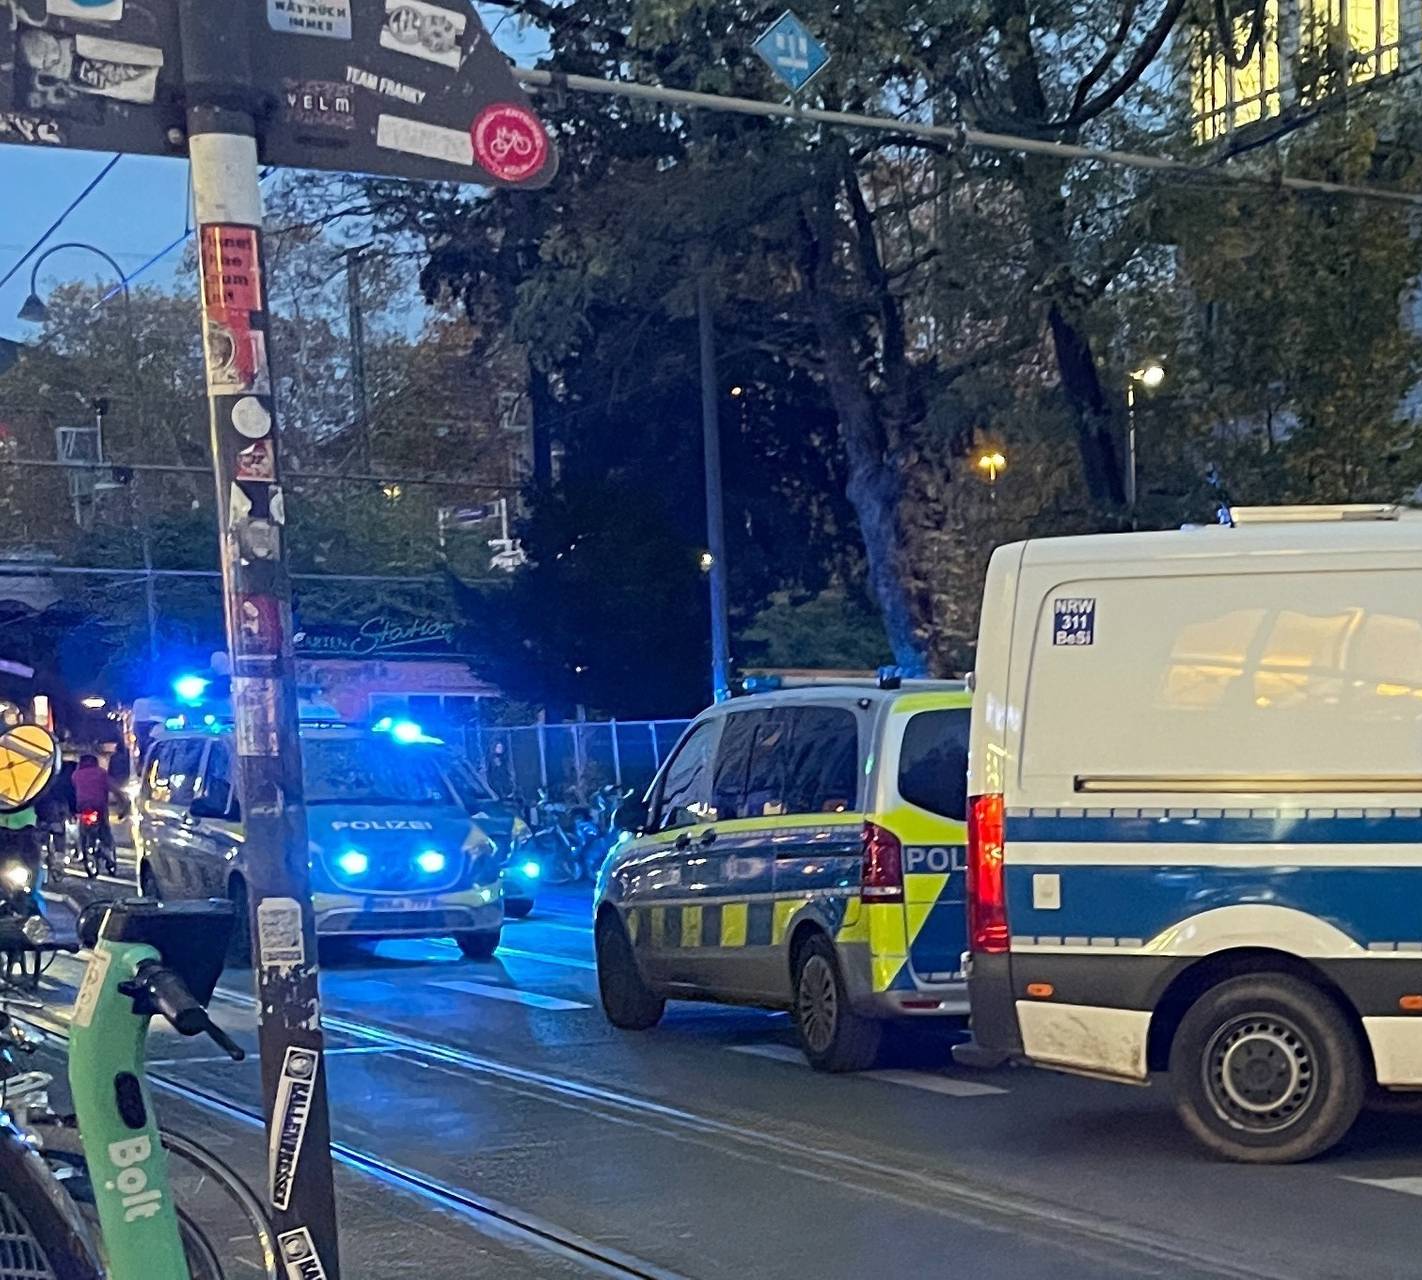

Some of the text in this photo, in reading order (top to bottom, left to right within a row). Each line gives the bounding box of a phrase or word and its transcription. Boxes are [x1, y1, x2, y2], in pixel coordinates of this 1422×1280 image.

[346, 66, 378, 90] TEAM
[1055, 600, 1094, 614] NRW
[1061, 614, 1087, 630] 311
[331, 820, 433, 831] POLIZEI
[106, 1134, 162, 1223] Bolt
